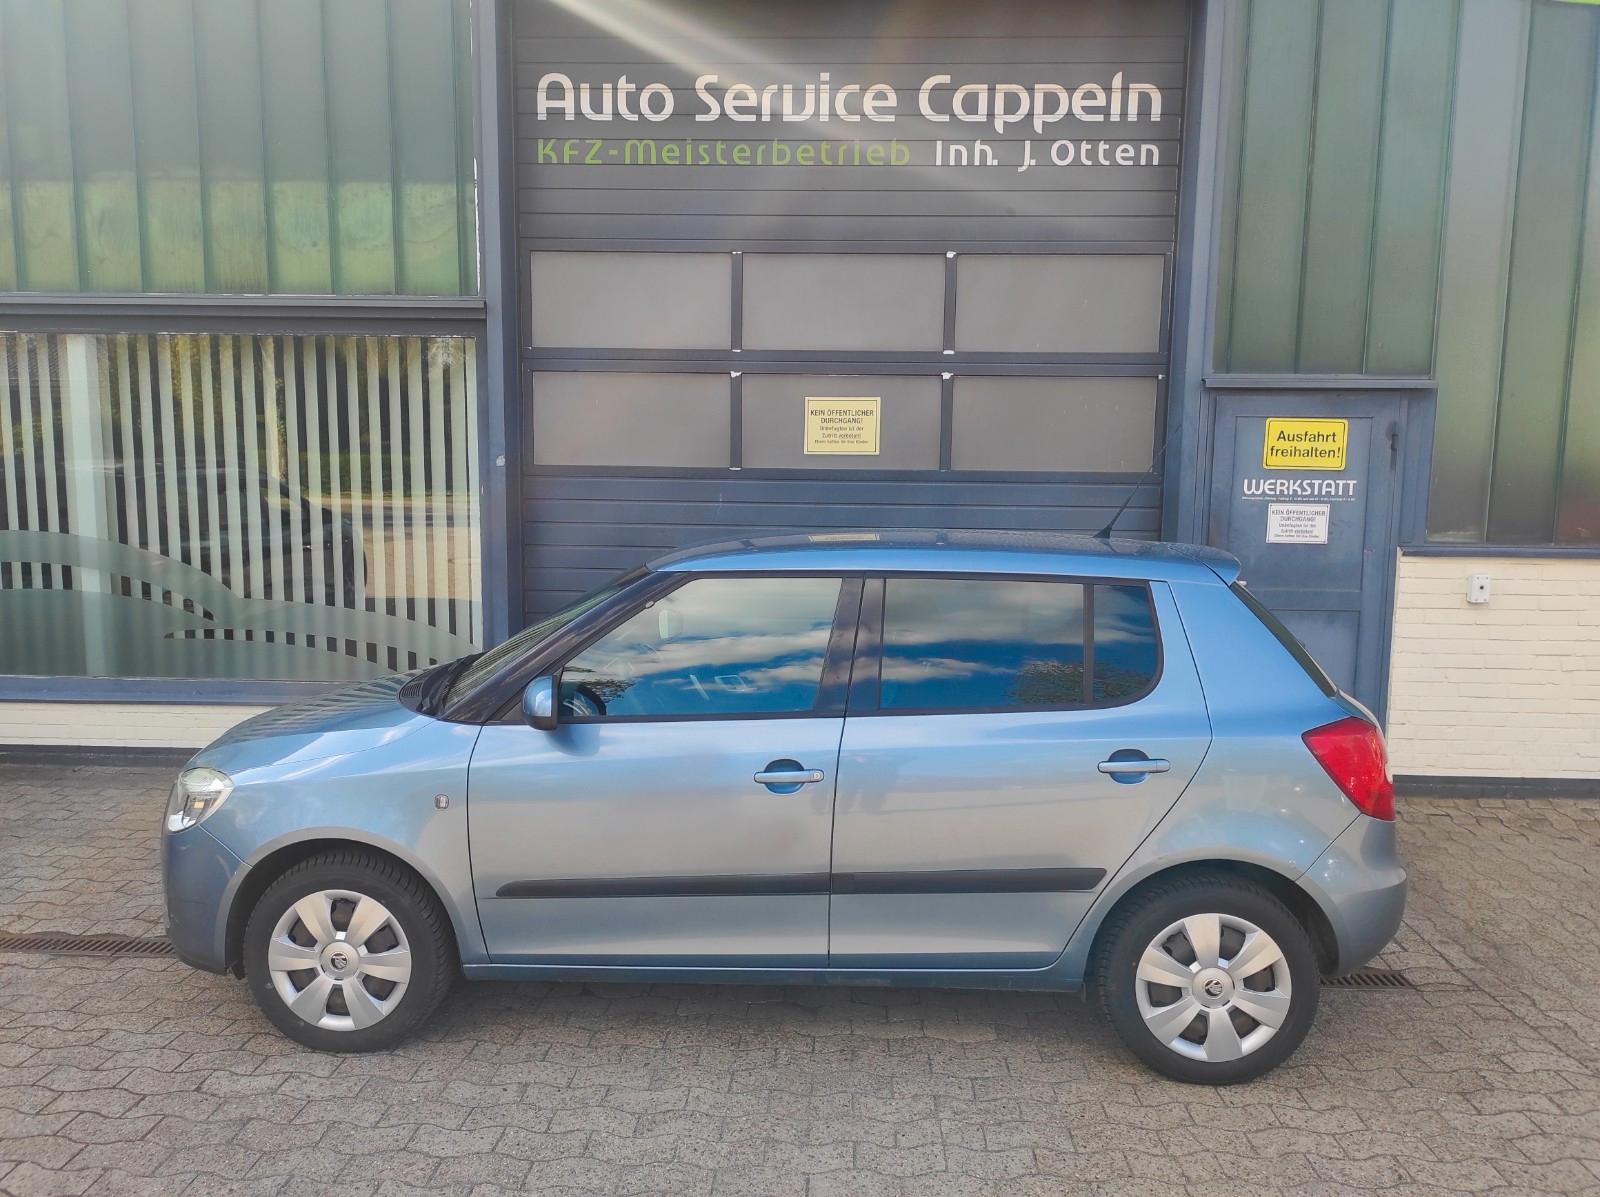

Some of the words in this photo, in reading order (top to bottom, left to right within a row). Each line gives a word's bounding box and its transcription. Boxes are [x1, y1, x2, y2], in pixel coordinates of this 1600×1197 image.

[537, 72, 675, 122] Auto
[695, 72, 898, 122] Service
[918, 71, 1162, 134] Cappeln
[537, 138, 910, 166] KFZ-Meisterbetrieb
[935, 139, 998, 166] Inh.
[1017, 140, 1036, 172] J.
[1050, 139, 1159, 166] Otten
[810, 409, 825, 417] KEIN
[827, 408, 874, 417] ÖFFENTLICHER
[1276, 430, 1337, 443] Ausfahrt
[1270, 445, 1341, 458] freihalten!
[1243, 479, 1357, 496] WERKSTATT
